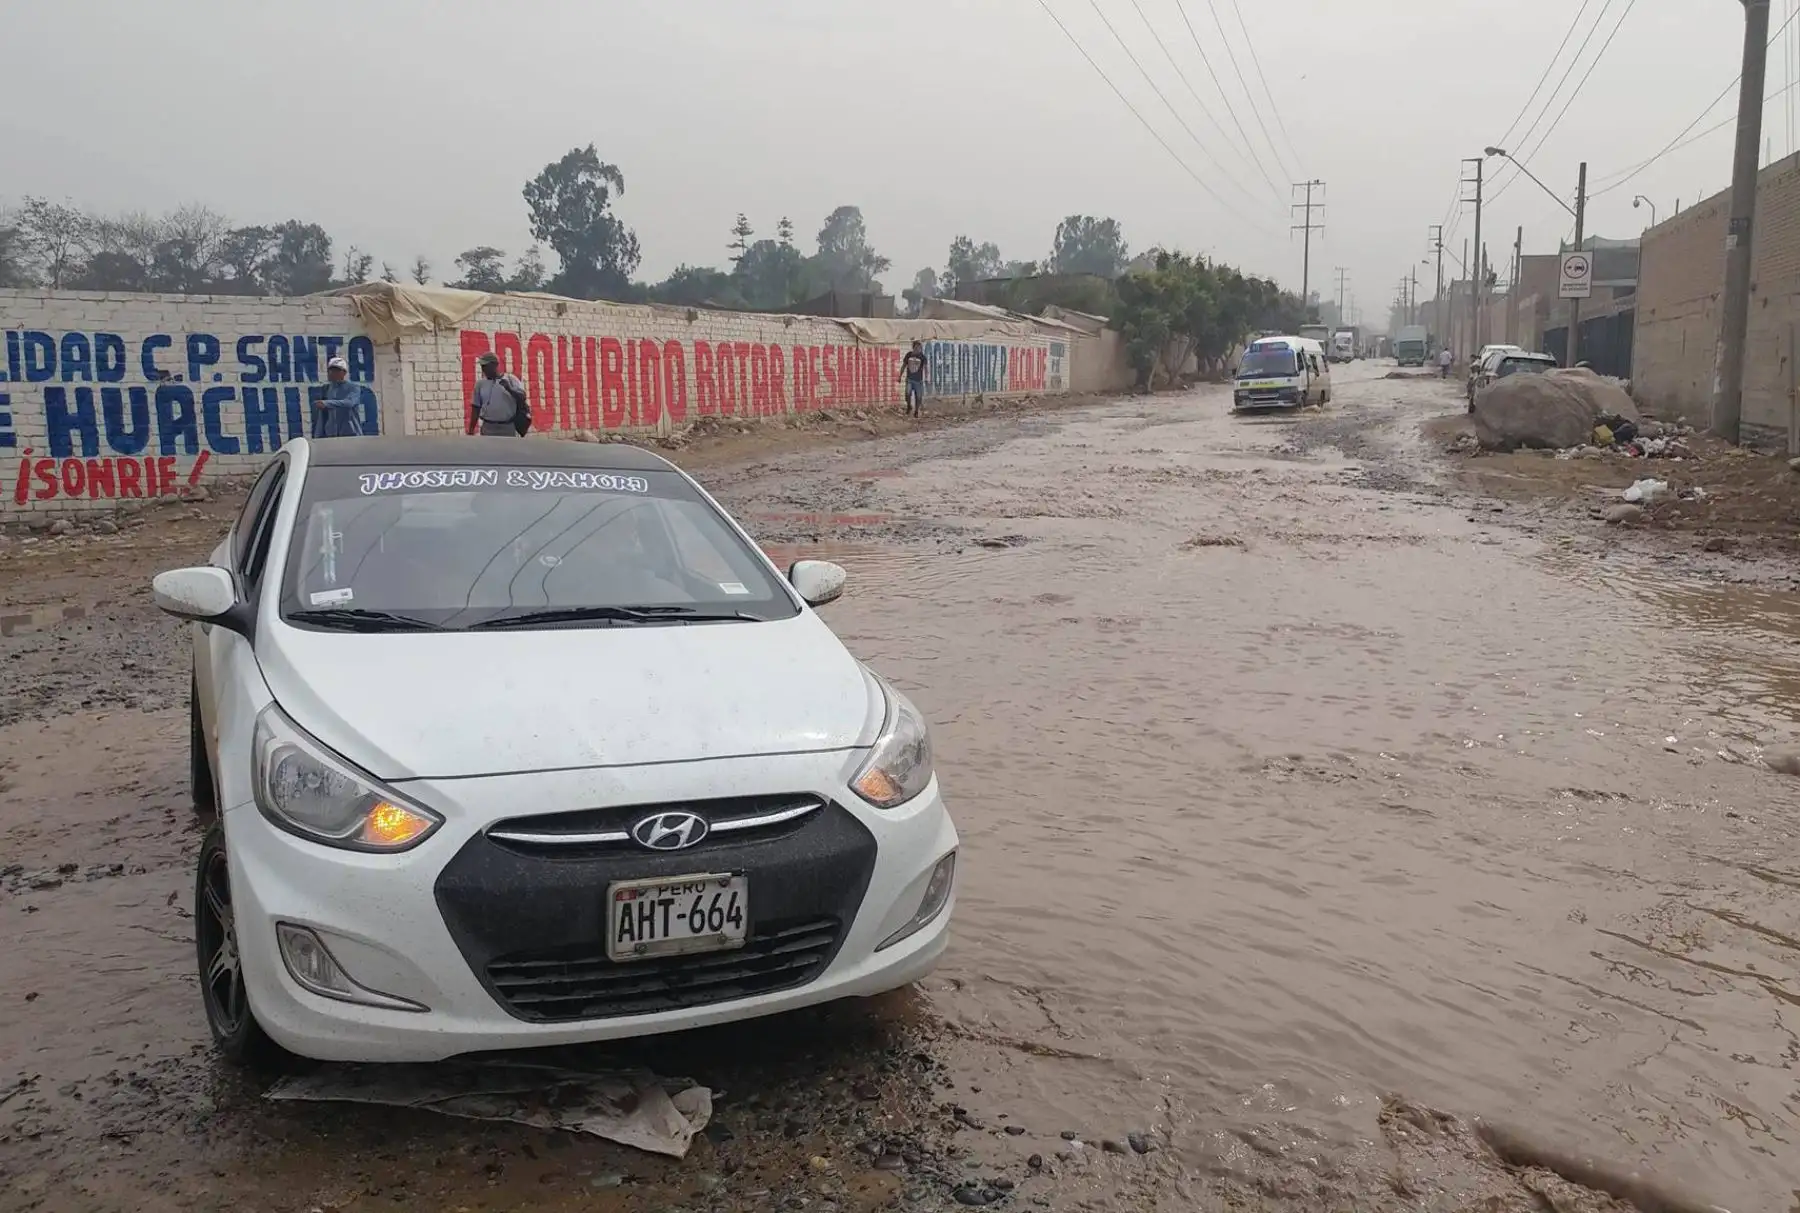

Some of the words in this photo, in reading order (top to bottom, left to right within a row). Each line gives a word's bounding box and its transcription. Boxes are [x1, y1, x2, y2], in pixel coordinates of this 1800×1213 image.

[0, 331, 126, 382] IDAD
[237, 335, 375, 383] SANTA
[694, 340, 786, 416] BOTAR
[793, 343, 900, 413] DESMONTE
[923, 341, 970, 395] OGELIO
[44, 386, 380, 458] HUACHIA
[617, 891, 743, 943] AHT-664
